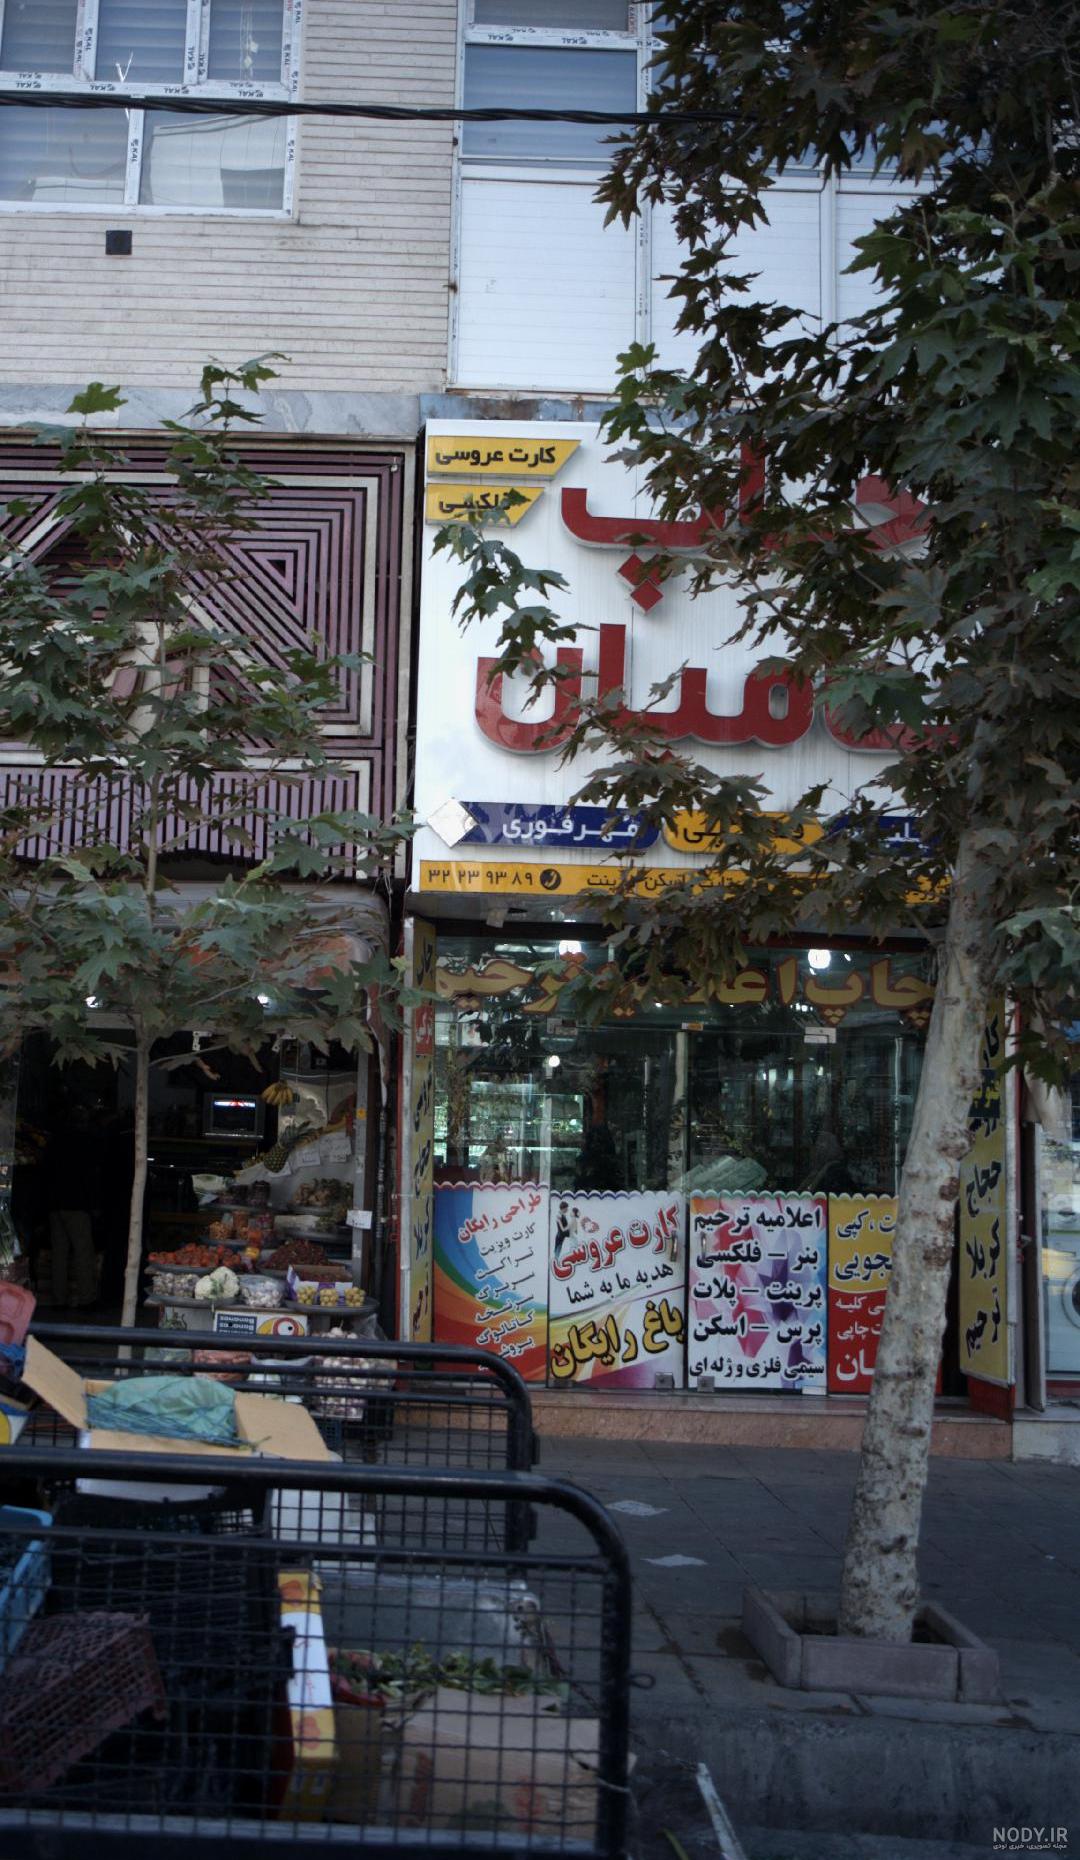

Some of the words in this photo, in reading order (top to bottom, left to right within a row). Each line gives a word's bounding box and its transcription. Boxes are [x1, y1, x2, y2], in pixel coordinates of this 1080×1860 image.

[435, 448, 504, 466] عروسی
[508, 446, 556, 467] کارت
[502, 813, 575, 840] فوری
[428, 868, 451, 884] ۳۲
[458, 869, 480, 885] ۲۳
[486, 870, 507, 886] ۹۳
[511, 871, 533, 886] ۸۹
[804, 955, 936, 1028] چاپ
[966, 1160, 1002, 1218] حجاج
[501, 1192, 542, 1224] طراحی
[694, 1206, 750, 1234] ترحیم
[756, 1206, 821, 1233] اعلامیه
[458, 1214, 498, 1243] رایگان
[512, 1222, 536, 1242] کارت
[627, 1203, 680, 1254] کارت
[837, 1210, 870, 1239] کپی
[479, 1235, 511, 1257] ویزیت
[552, 1226, 626, 1281] عروسی
[696, 1239, 762, 1269] فلکسی
[792, 1247, 818, 1271] بنر
[965, 1216, 1001, 1279] کربلا
[476, 1247, 534, 1280] تراکت
[636, 1263, 673, 1289] هدیه
[477, 1272, 535, 1301] سربرگ
[566, 1280, 594, 1304] شما
[600, 1282, 613, 1299] به
[616, 1272, 631, 1289] ما
[693, 1277, 736, 1307] پلات
[766, 1281, 822, 1308] پرینت
[835, 1295, 868, 1312] کلیه
[475, 1294, 534, 1323] سرنسخه
[476, 1311, 534, 1345] کاتالوگ
[642, 1297, 686, 1354] باغ
[693, 1314, 746, 1342] اسکن
[776, 1322, 822, 1345] پرس
[836, 1320, 870, 1340] چاپی
[965, 1286, 1001, 1359] ترحیم
[499, 1336, 534, 1358] بروش
[550, 1313, 639, 1379] رایگان
[689, 1356, 708, 1378] ای
[710, 1357, 733, 1378] ژله
[734, 1364, 743, 1377] و
[746, 1356, 781, 1379] فلزی
[784, 1364, 825, 1379] سیمی
